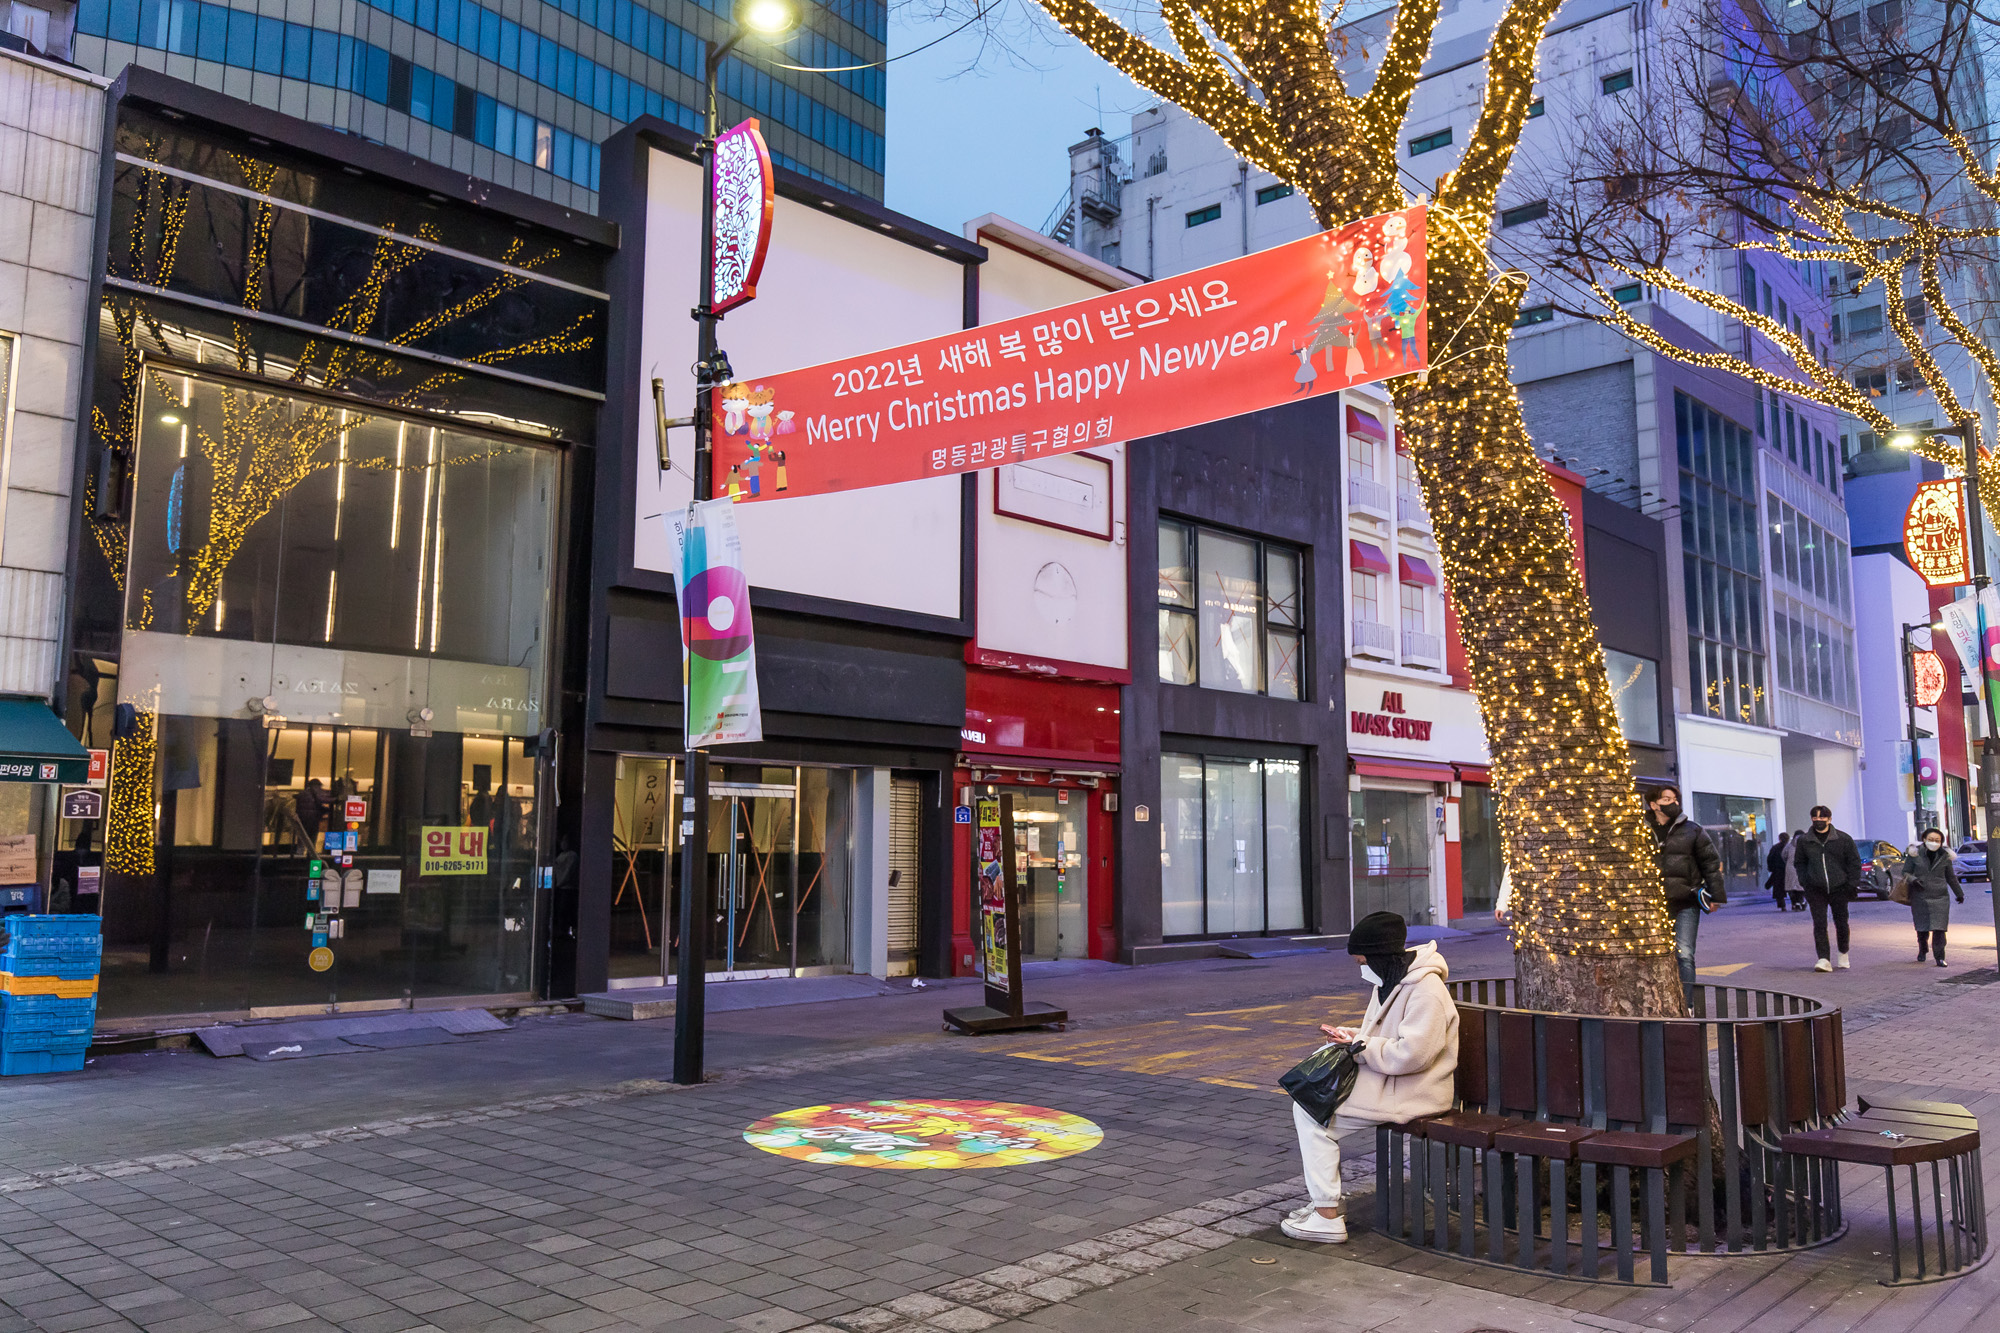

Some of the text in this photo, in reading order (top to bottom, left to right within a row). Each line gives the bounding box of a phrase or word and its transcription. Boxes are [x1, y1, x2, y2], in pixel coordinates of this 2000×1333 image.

[832, 280, 1237, 397] 2022년 새해 복 많이 받으세요
[806, 320, 1287, 445] Merry Christmas Happy Newyear
[932, 415, 1113, 470] 명동관광특구협의회
[1380, 690, 1406, 714] ALL
[1351, 710, 1432, 741] MASK STORY
[0, 764, 34, 776] 편의점
[71, 804, 92, 815] 3-1
[425, 861, 484, 871] 010-6265-5171
